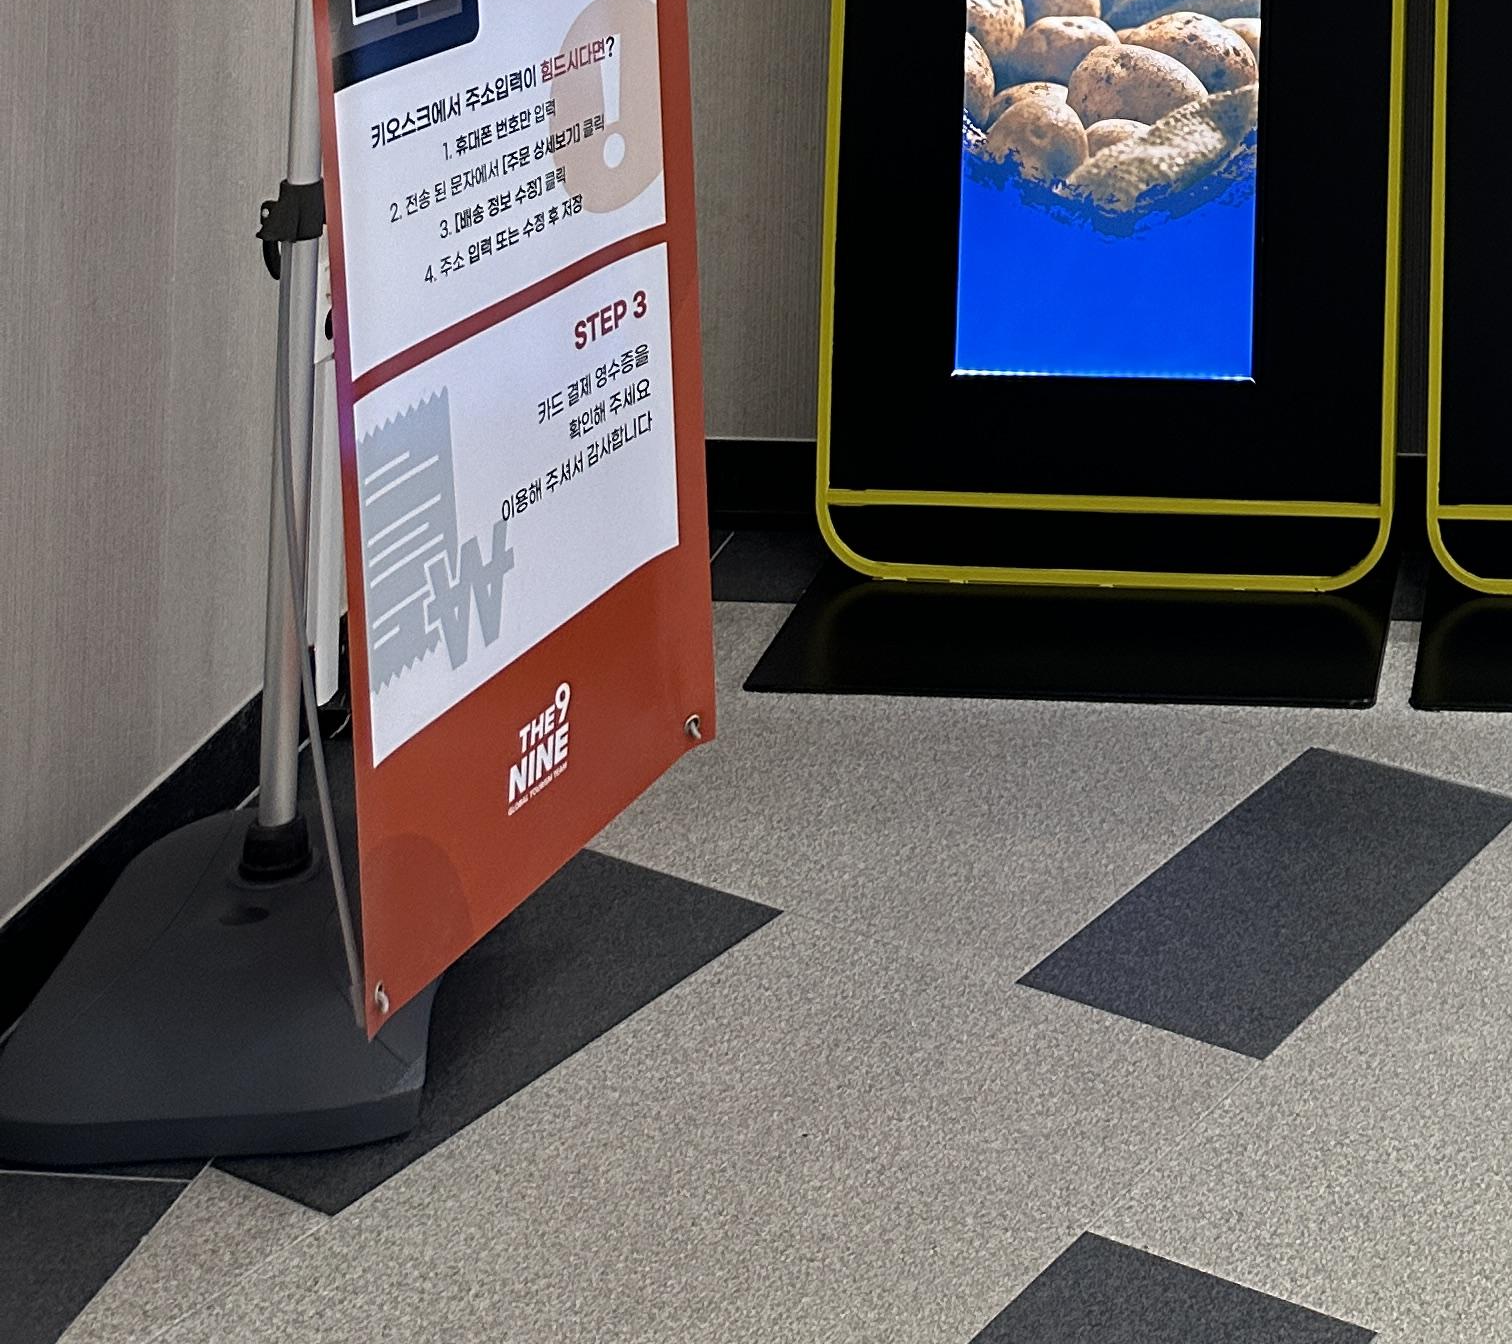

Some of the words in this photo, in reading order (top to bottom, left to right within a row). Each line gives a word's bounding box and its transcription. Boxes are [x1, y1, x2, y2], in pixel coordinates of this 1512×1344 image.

[371, 92, 462, 149] 키오스크에서
[465, 64, 537, 111] 주소입력이
[540, 35, 615, 82] 힘드시다면?
[442, 141, 453, 160] 1.
[455, 127, 493, 155] 휴대폰
[495, 108, 532, 140] 번호만
[534, 98, 557, 124] 입력
[389, 202, 403, 223] 2.
[405, 190, 431, 216] 전송
[434, 180, 448, 203] 된
[450, 159, 500, 197] 문자에서
[502, 147, 531, 176] [주문
[533, 124, 581, 160] 상세보기]
[583, 113, 606, 139] 클릭
[439, 220, 453, 239] 3.
[455, 203, 484, 235] [배송
[487, 190, 511, 218] 정보
[515, 174, 543, 205] 수정]
[545, 165, 567, 192] 클릭
[424, 264, 437, 284] 4.
[439, 250, 466, 277] 주소
[468, 236, 493, 264] 입력
[495, 223, 520, 252] 또는
[522, 212, 546, 239] 수정
[548, 205, 559, 228] 후
[561, 193, 584, 220] 저장
[574, 299, 628, 351] STEP
[632, 290, 648, 319] 3
[537, 396, 564, 424] 카드
[567, 373, 592, 407] 결제
[595, 343, 650, 389] 영수증을
[569, 399, 607, 440] 확인해
[609, 377, 651, 417] 주세요
[501, 478, 543, 522] 이용해
[545, 451, 584, 494] 주셔서
[586, 410, 653, 467] 감사합니다
[519, 703, 556, 754] THE
[555, 682, 571, 724] 9
[508, 722, 570, 804] NINE
